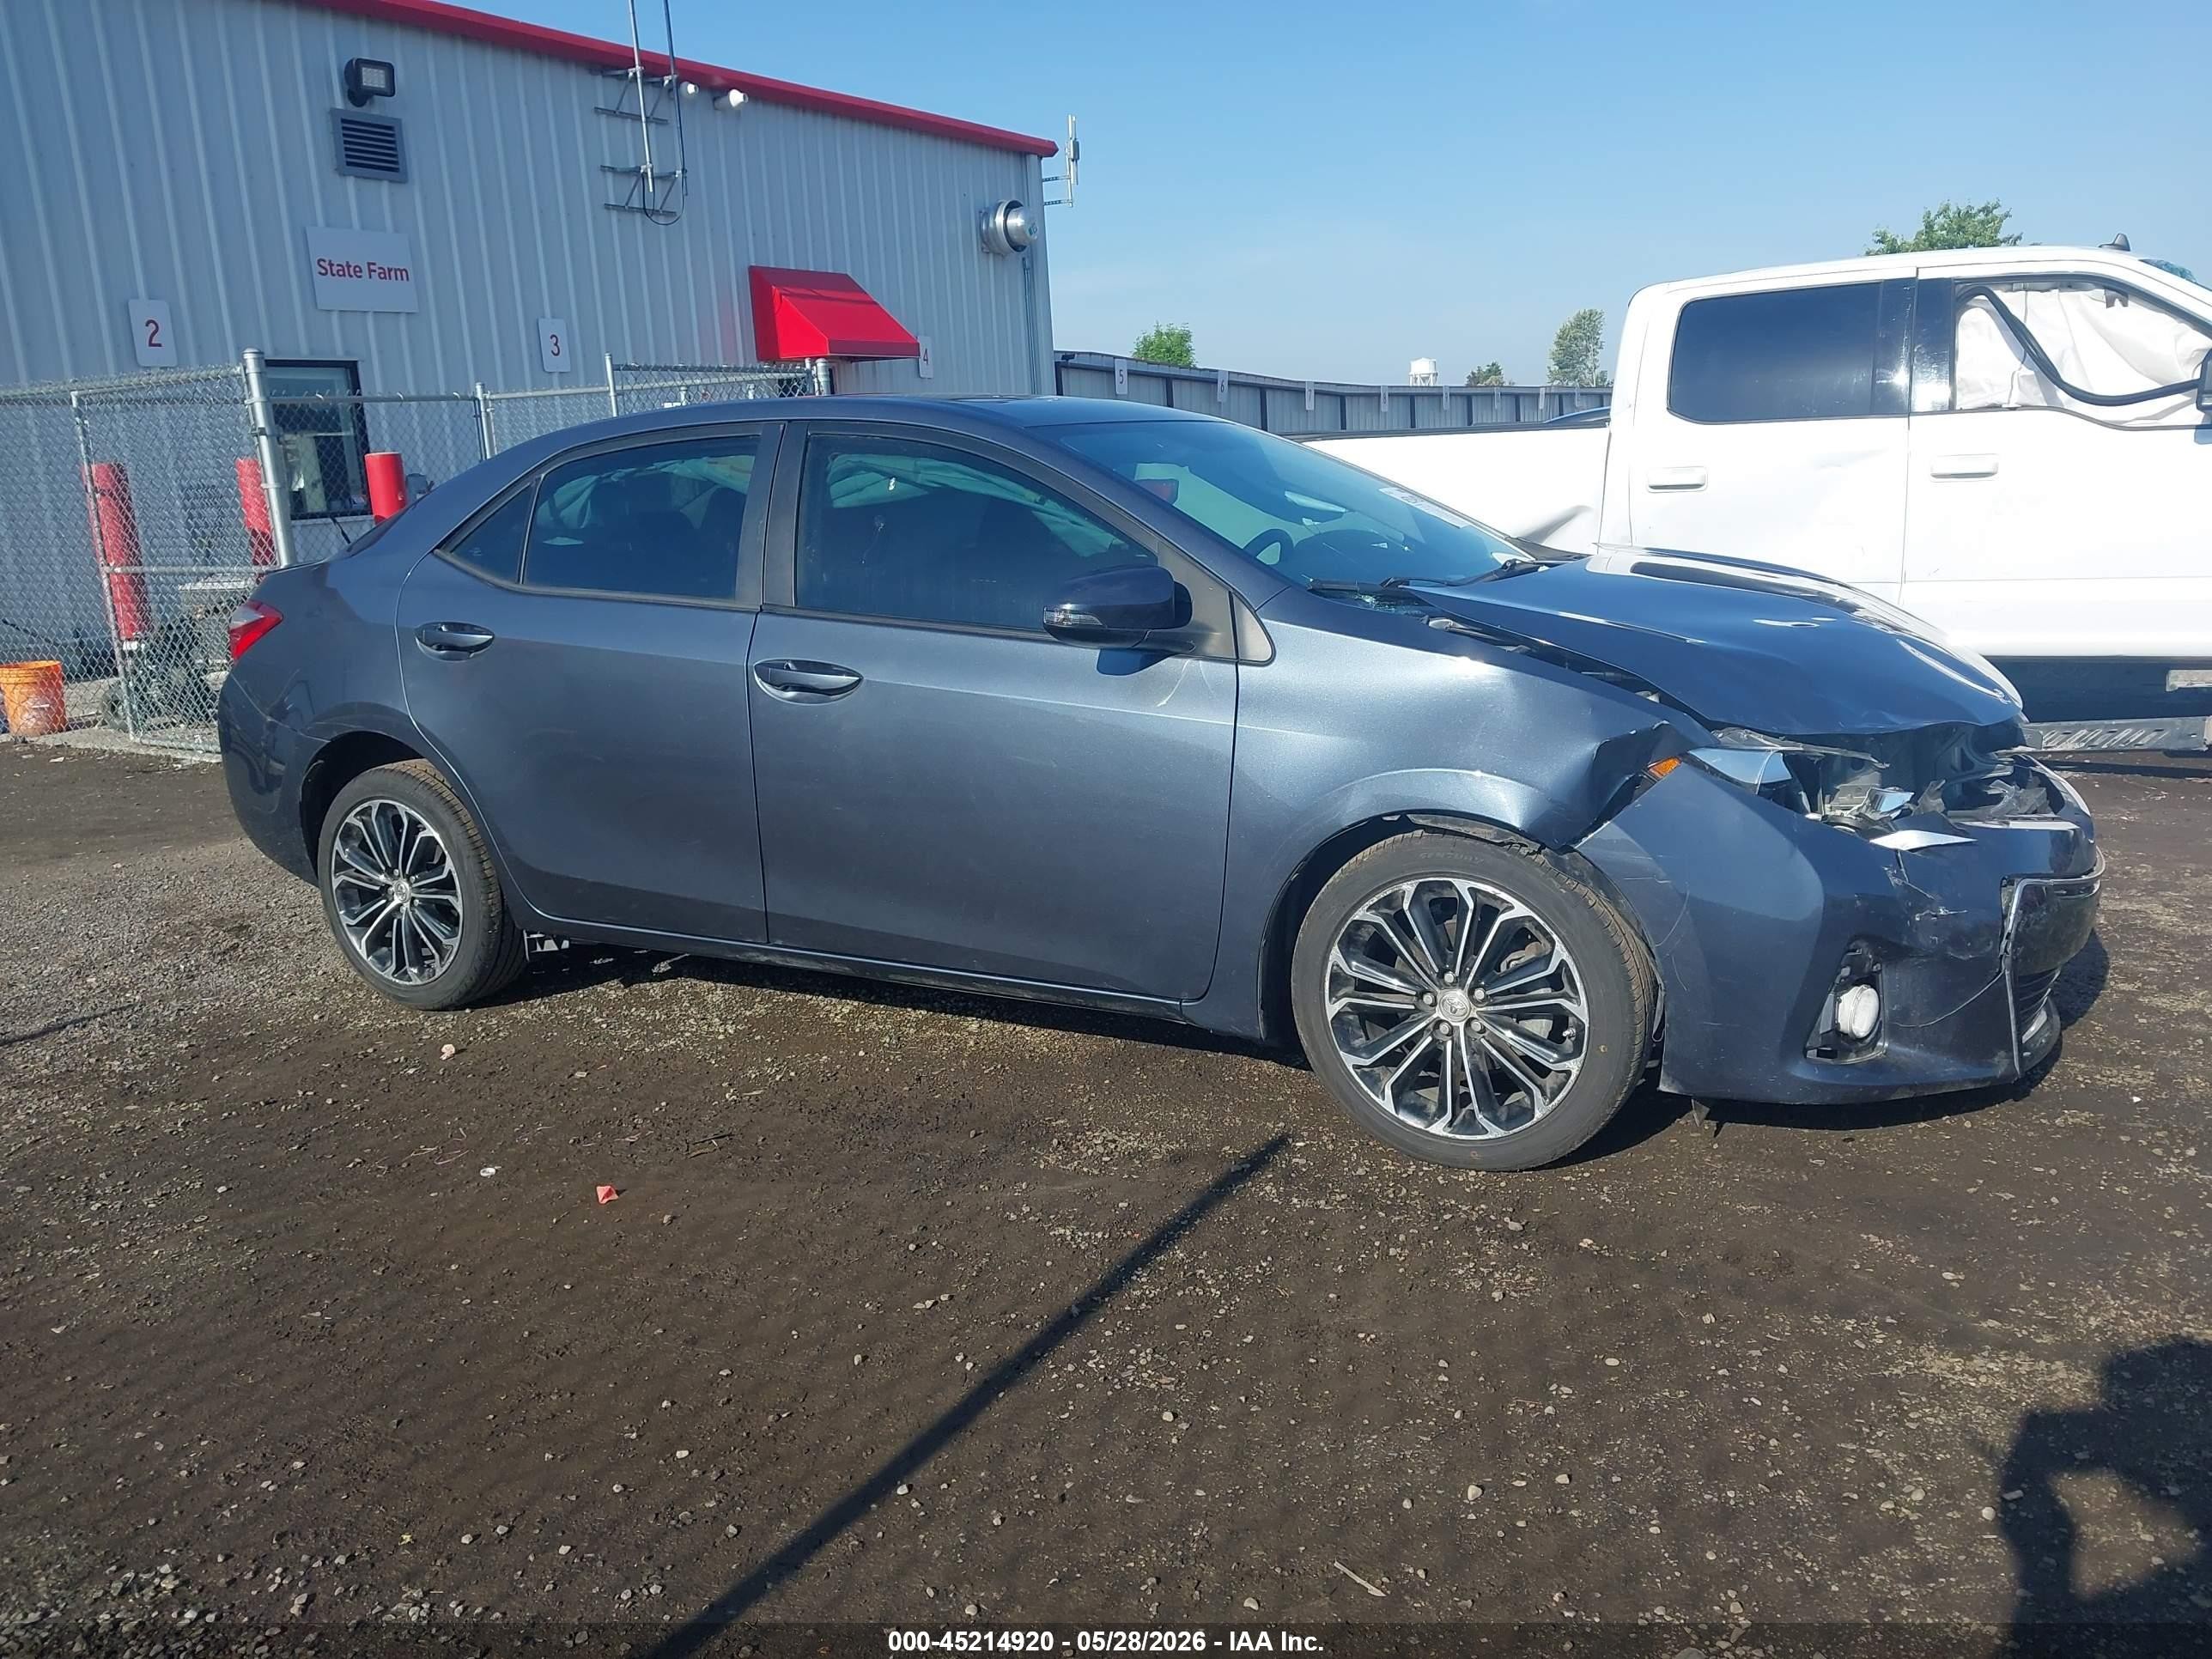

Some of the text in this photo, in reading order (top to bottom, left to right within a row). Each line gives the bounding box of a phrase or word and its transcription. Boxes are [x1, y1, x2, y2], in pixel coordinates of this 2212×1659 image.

[316, 258, 410, 282] State Farm
[145, 319, 163, 348] 2
[550, 334, 561, 356] 3
[922, 348, 929, 365] 4
[1119, 369, 1124, 385] 5
[1220, 380, 1224, 392] 6
